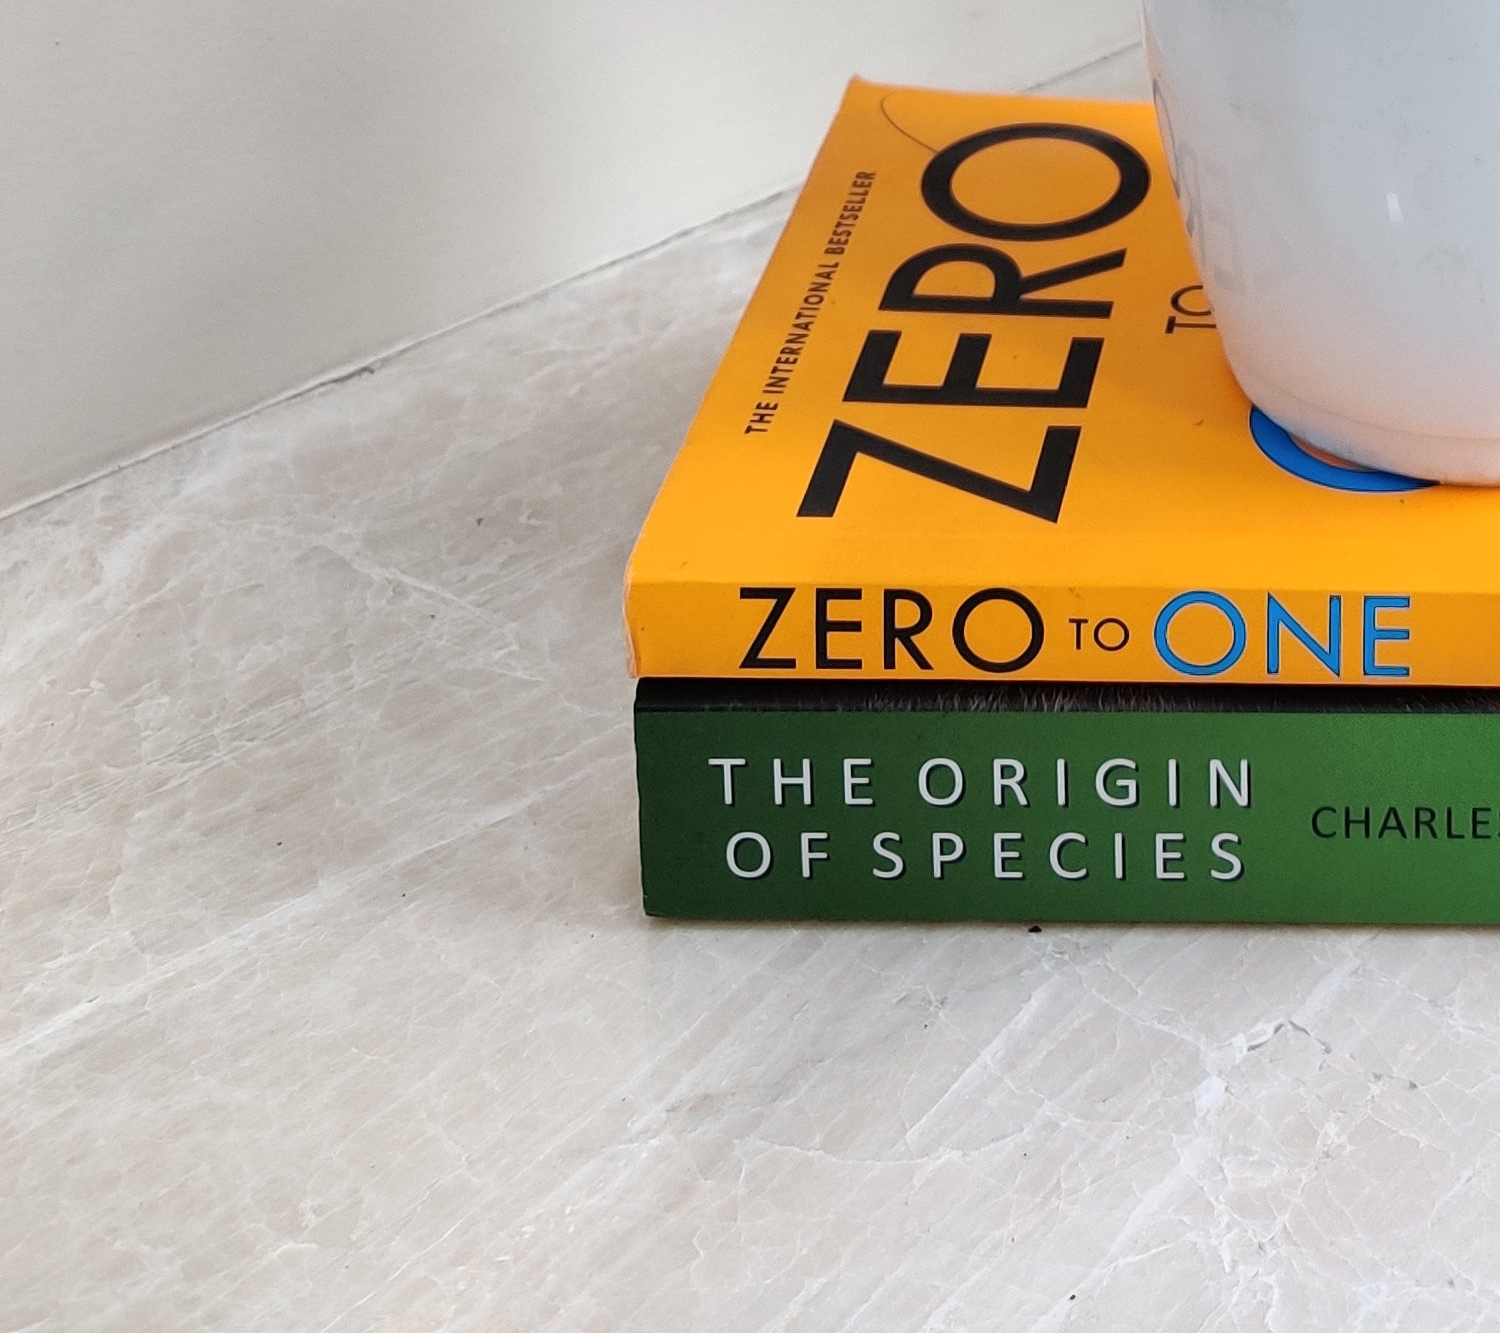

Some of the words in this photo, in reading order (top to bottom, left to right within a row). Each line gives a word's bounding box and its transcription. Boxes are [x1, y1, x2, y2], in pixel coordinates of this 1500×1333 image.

[745, 402, 779, 434] THE
[762, 261, 840, 394] INTERNATIONAL
[824, 171, 877, 255] BESTSELLER
[796, 122, 1150, 523] ZERO
[738, 587, 1045, 673] ZERO
[1069, 617, 1131, 652] TO
[1153, 589, 1413, 678] ONE
[707, 757, 875, 807] THE
[917, 757, 1253, 808] ORIGIN
[725, 831, 833, 880] OF
[873, 831, 1245, 881] SPECIES
